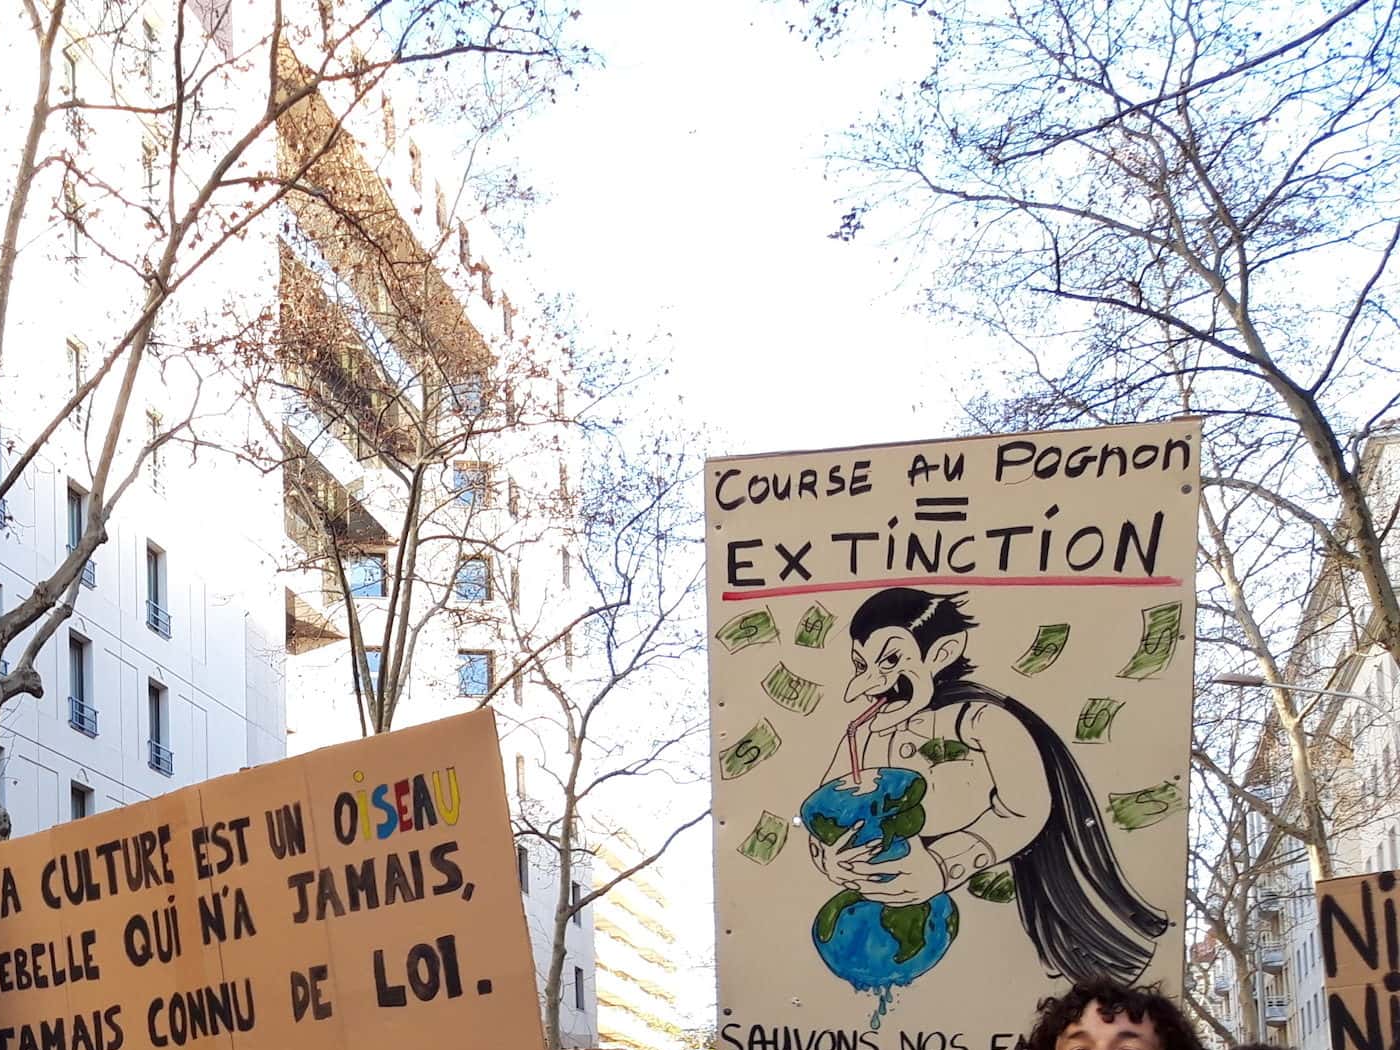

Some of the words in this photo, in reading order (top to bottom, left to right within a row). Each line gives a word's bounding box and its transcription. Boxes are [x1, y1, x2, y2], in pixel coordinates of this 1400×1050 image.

[715, 459, 873, 512] COURSE
[907, 452, 965, 487] AU
[41, 823, 175, 910] CULTURE
[193, 815, 250, 880] EST
[267, 800, 306, 860] UN
[200, 884, 257, 946] N'A
[288, 840, 475, 925] JAMAIS,
[147, 977, 256, 1048] CONNU
[290, 963, 333, 1023] DE
[372, 933, 493, 1010] LOI.
